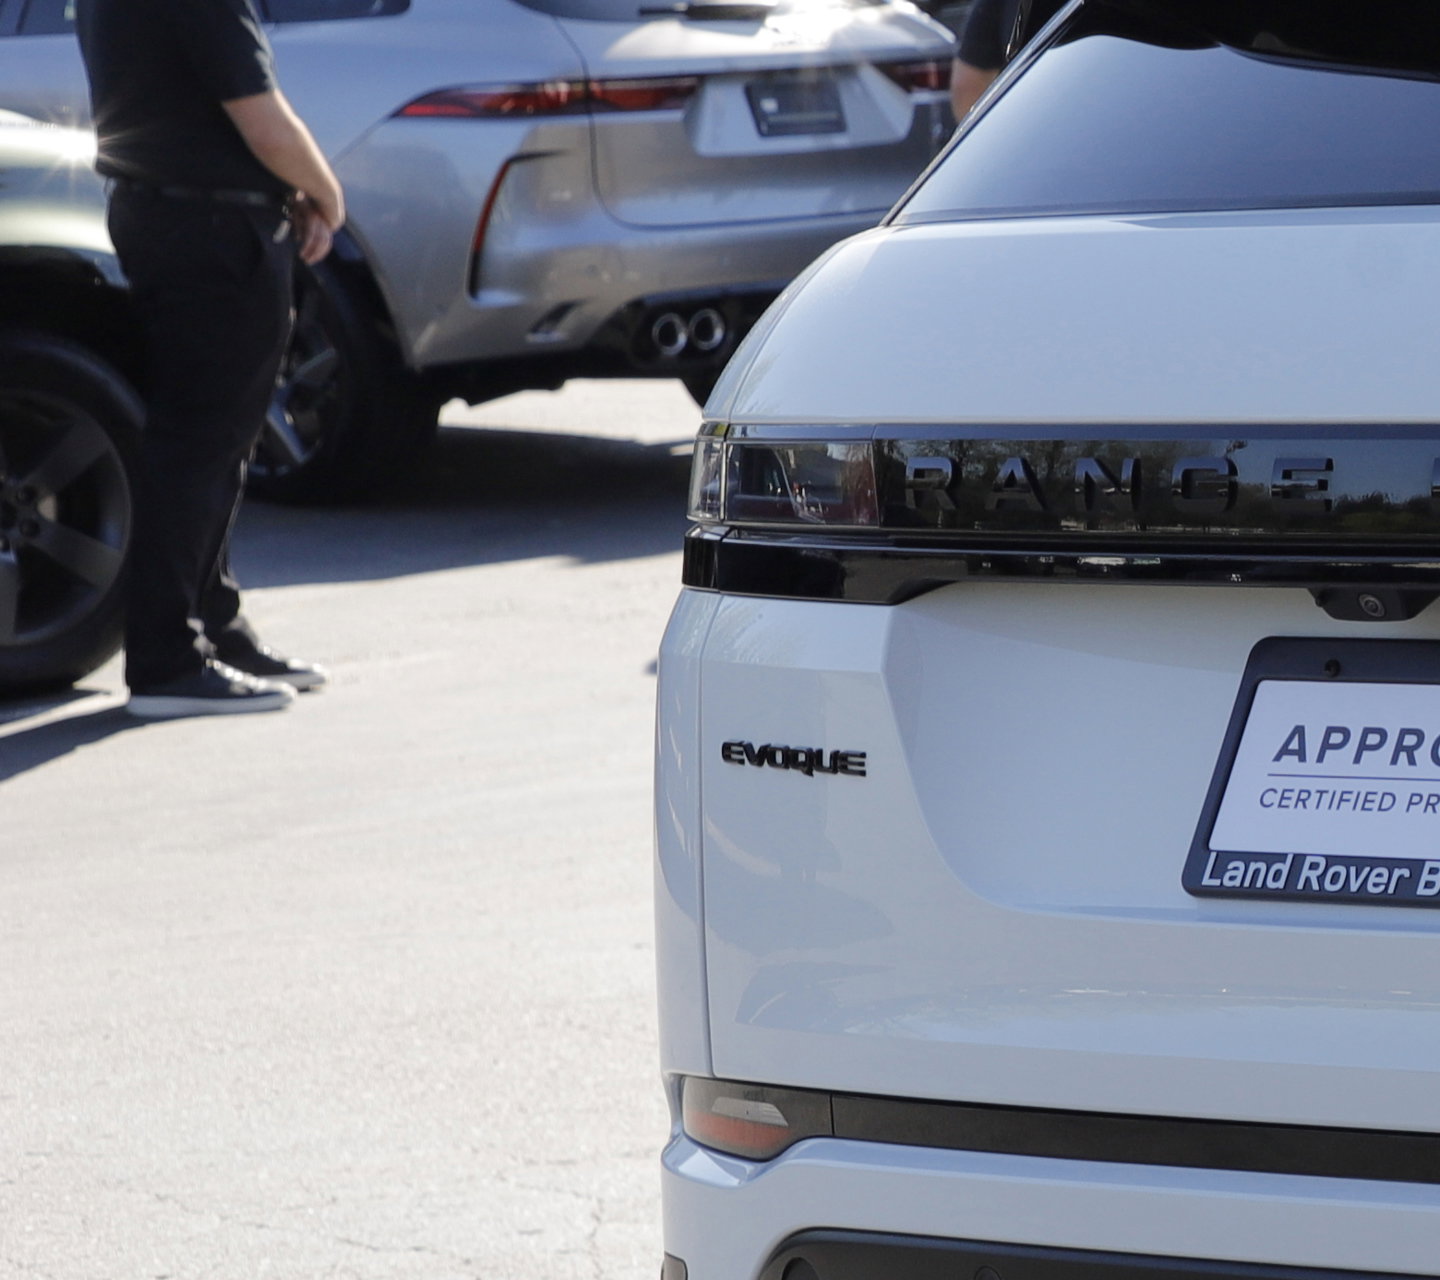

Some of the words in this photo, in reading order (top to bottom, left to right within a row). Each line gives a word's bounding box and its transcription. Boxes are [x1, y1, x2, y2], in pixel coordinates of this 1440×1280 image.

[904, 455, 1335, 514] RANGE
[721, 738, 867, 778] EVOQUE
[1258, 786, 1397, 813] CERTIFIED
[1201, 851, 1294, 890] Land
[1296, 856, 1411, 896] Rover
